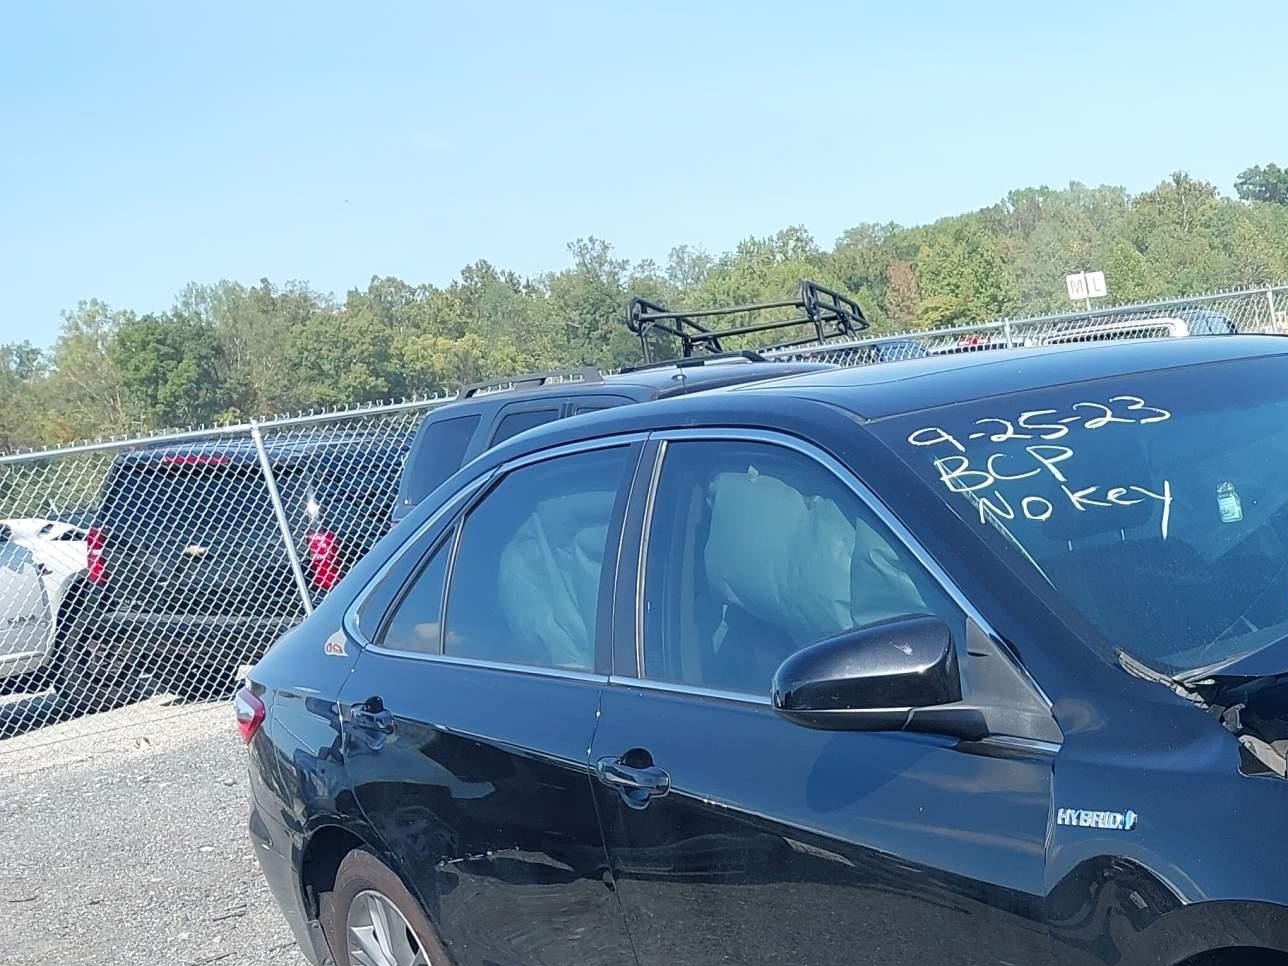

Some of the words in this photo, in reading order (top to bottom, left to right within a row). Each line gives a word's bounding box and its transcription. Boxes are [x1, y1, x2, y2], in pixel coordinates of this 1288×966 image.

[908, 395, 1172, 452] 9-25-23
[933, 445, 1074, 493] BCP
[1057, 807, 1122, 830] HYBRID
